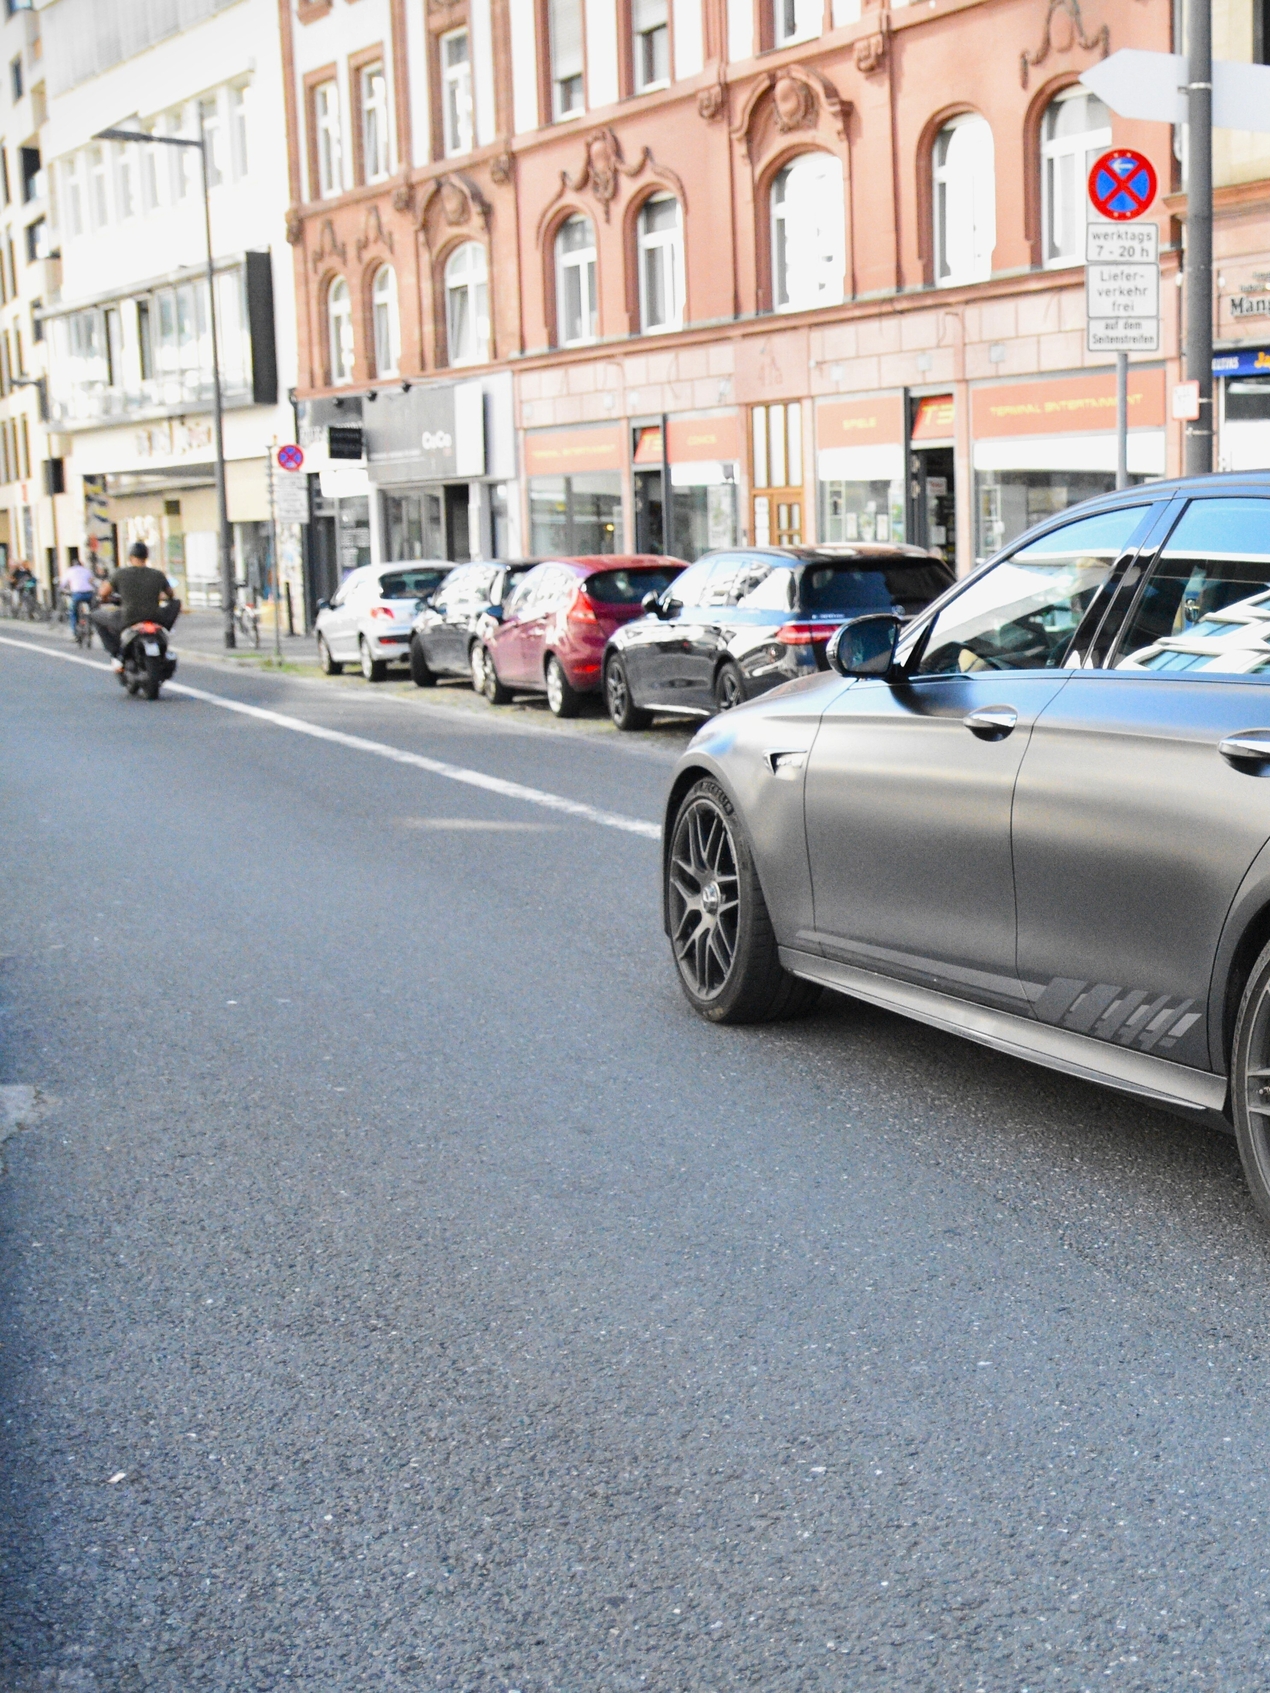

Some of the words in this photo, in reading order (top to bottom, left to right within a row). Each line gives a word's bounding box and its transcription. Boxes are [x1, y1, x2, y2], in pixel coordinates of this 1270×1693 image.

[1092, 230, 1152, 244] werktags
[1097, 245, 1104, 257] 7
[1119, 245, 1136, 258] 20
[1140, 245, 1149, 258] h
[1100, 270, 1145, 282] Liefer-
[1097, 285, 1148, 297] verkehr
[1111, 300, 1134, 312] frei
[1105, 321, 1119, 331] auf
[1123, 321, 1142, 331] dem
[1092, 332, 1155, 345] Seitenstreifen
